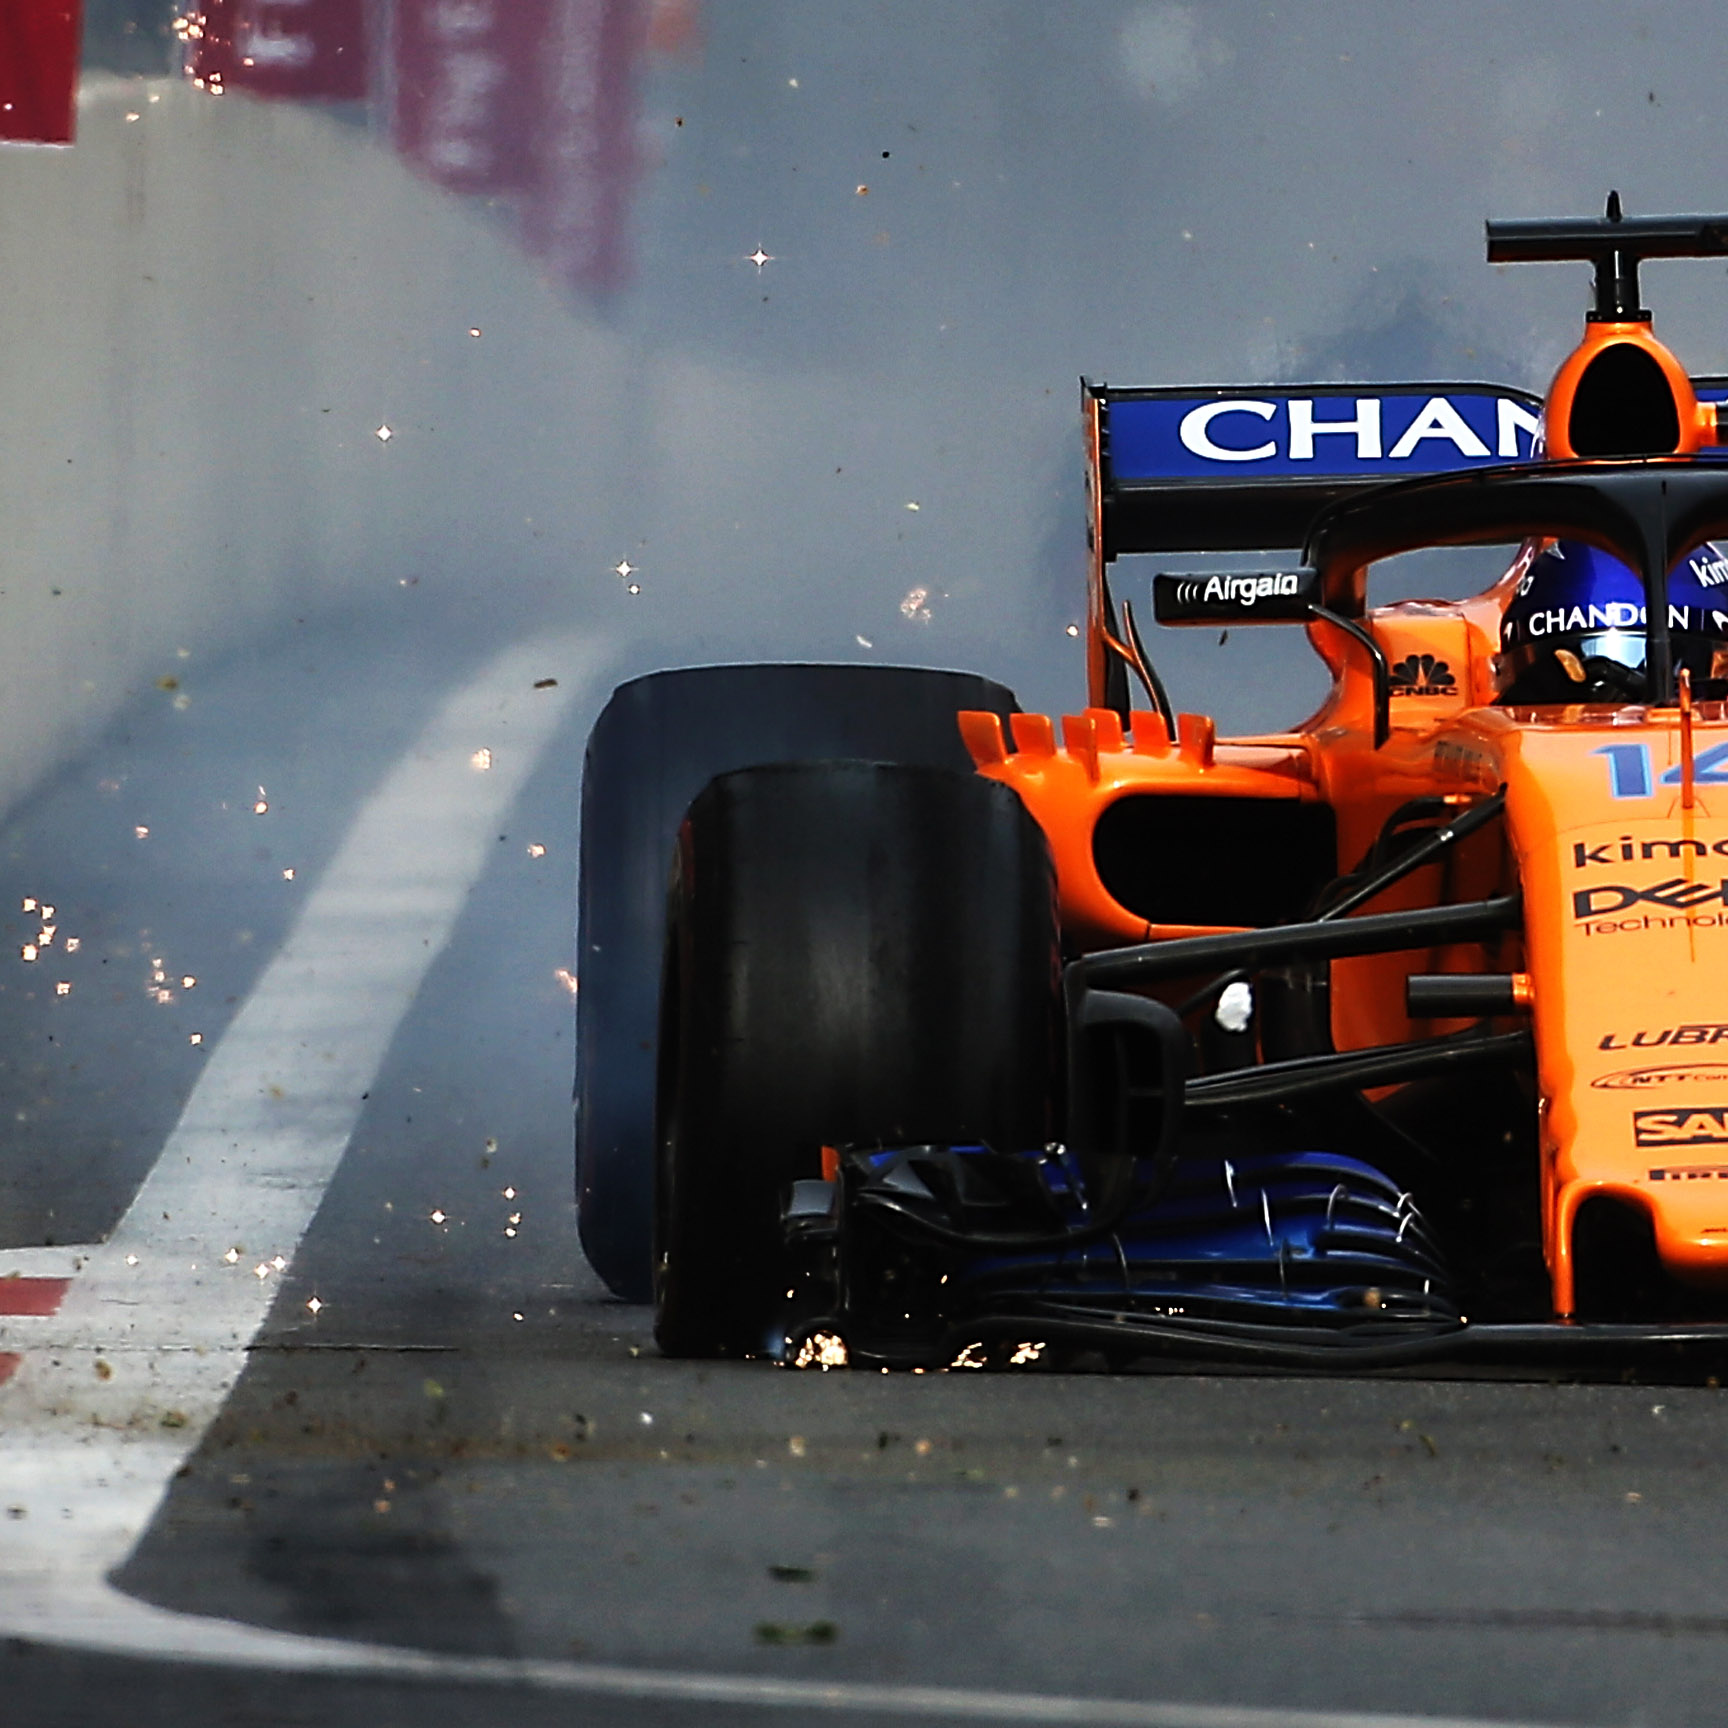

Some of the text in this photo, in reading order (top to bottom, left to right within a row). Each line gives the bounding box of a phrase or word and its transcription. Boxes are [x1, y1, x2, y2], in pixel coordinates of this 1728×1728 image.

[1203, 573, 1299, 606] Airgain
[1529, 602, 1690, 636] CHANDN
[1388, 686, 1459, 697] CNBC
[1630, 1073, 1694, 1084] NTT
